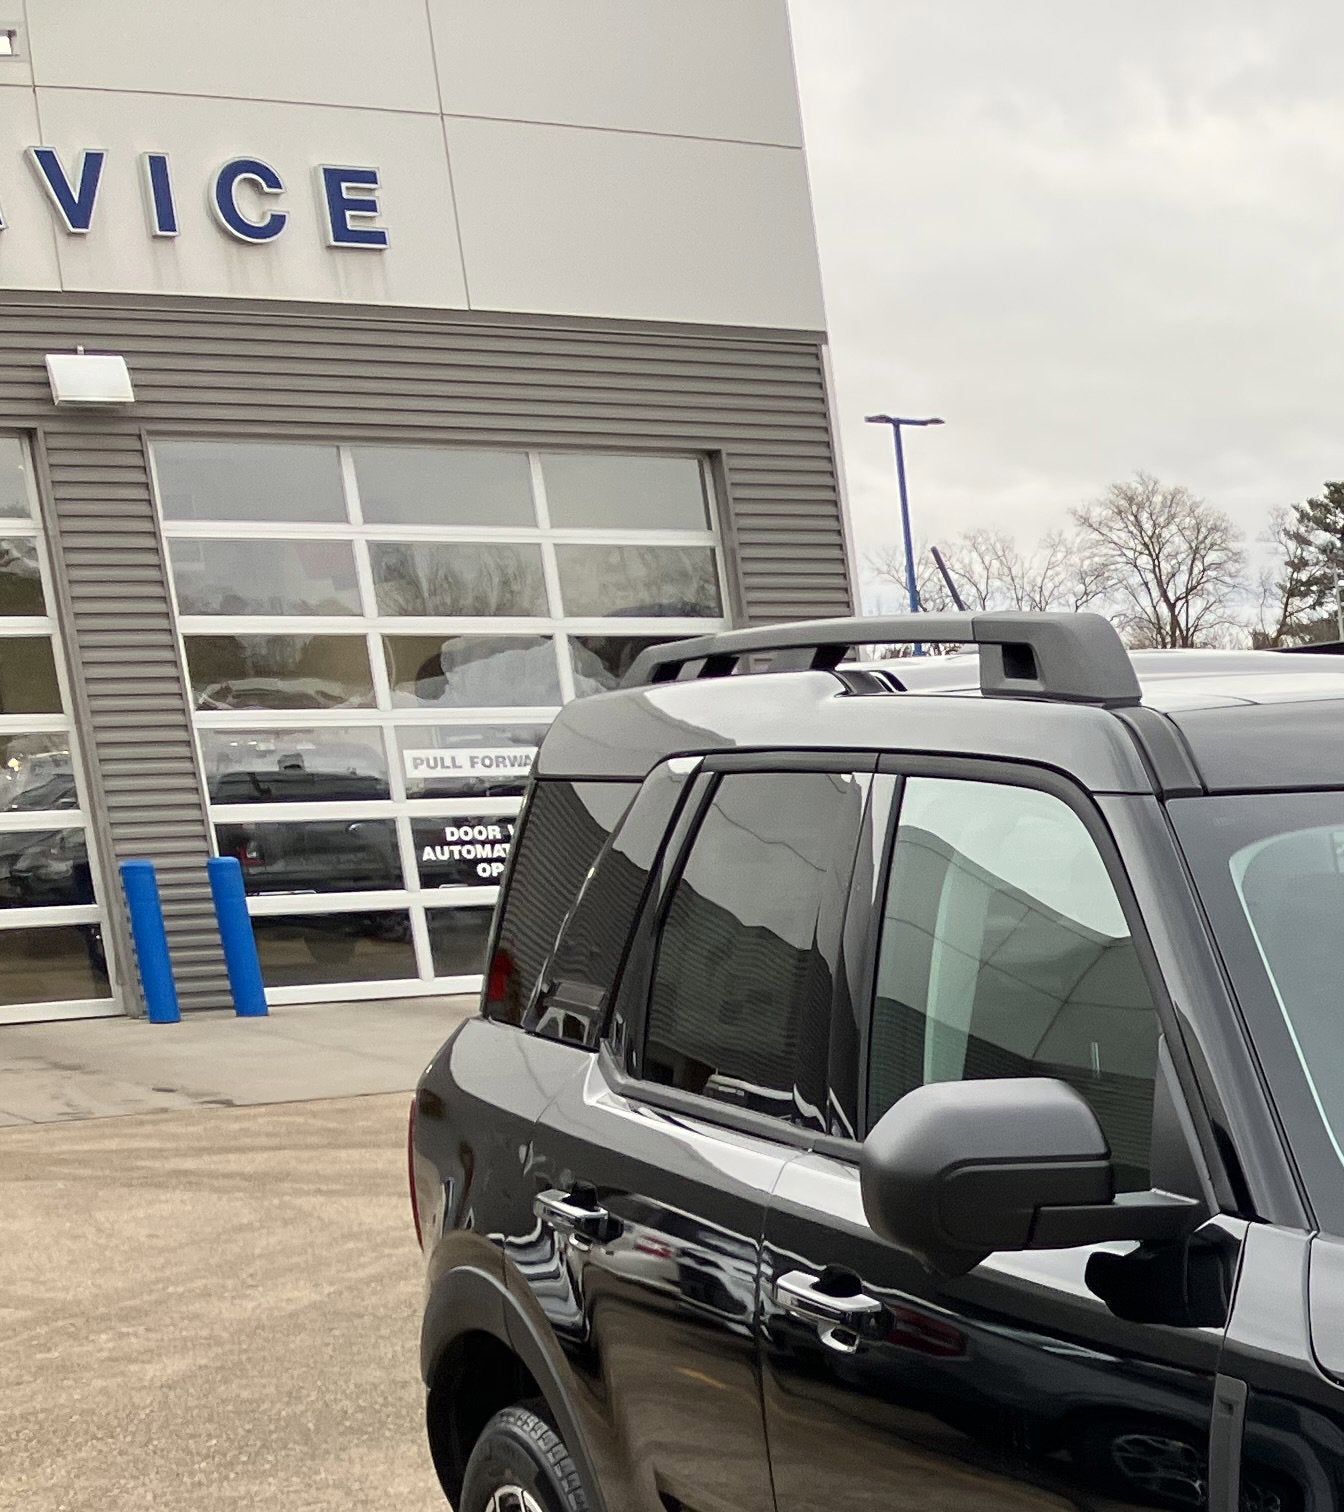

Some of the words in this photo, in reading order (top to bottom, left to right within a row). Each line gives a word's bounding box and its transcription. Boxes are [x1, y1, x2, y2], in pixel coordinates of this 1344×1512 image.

[0, 146, 390, 250] VICE
[412, 755, 463, 770] PULL
[445, 825, 502, 841] DOOR
